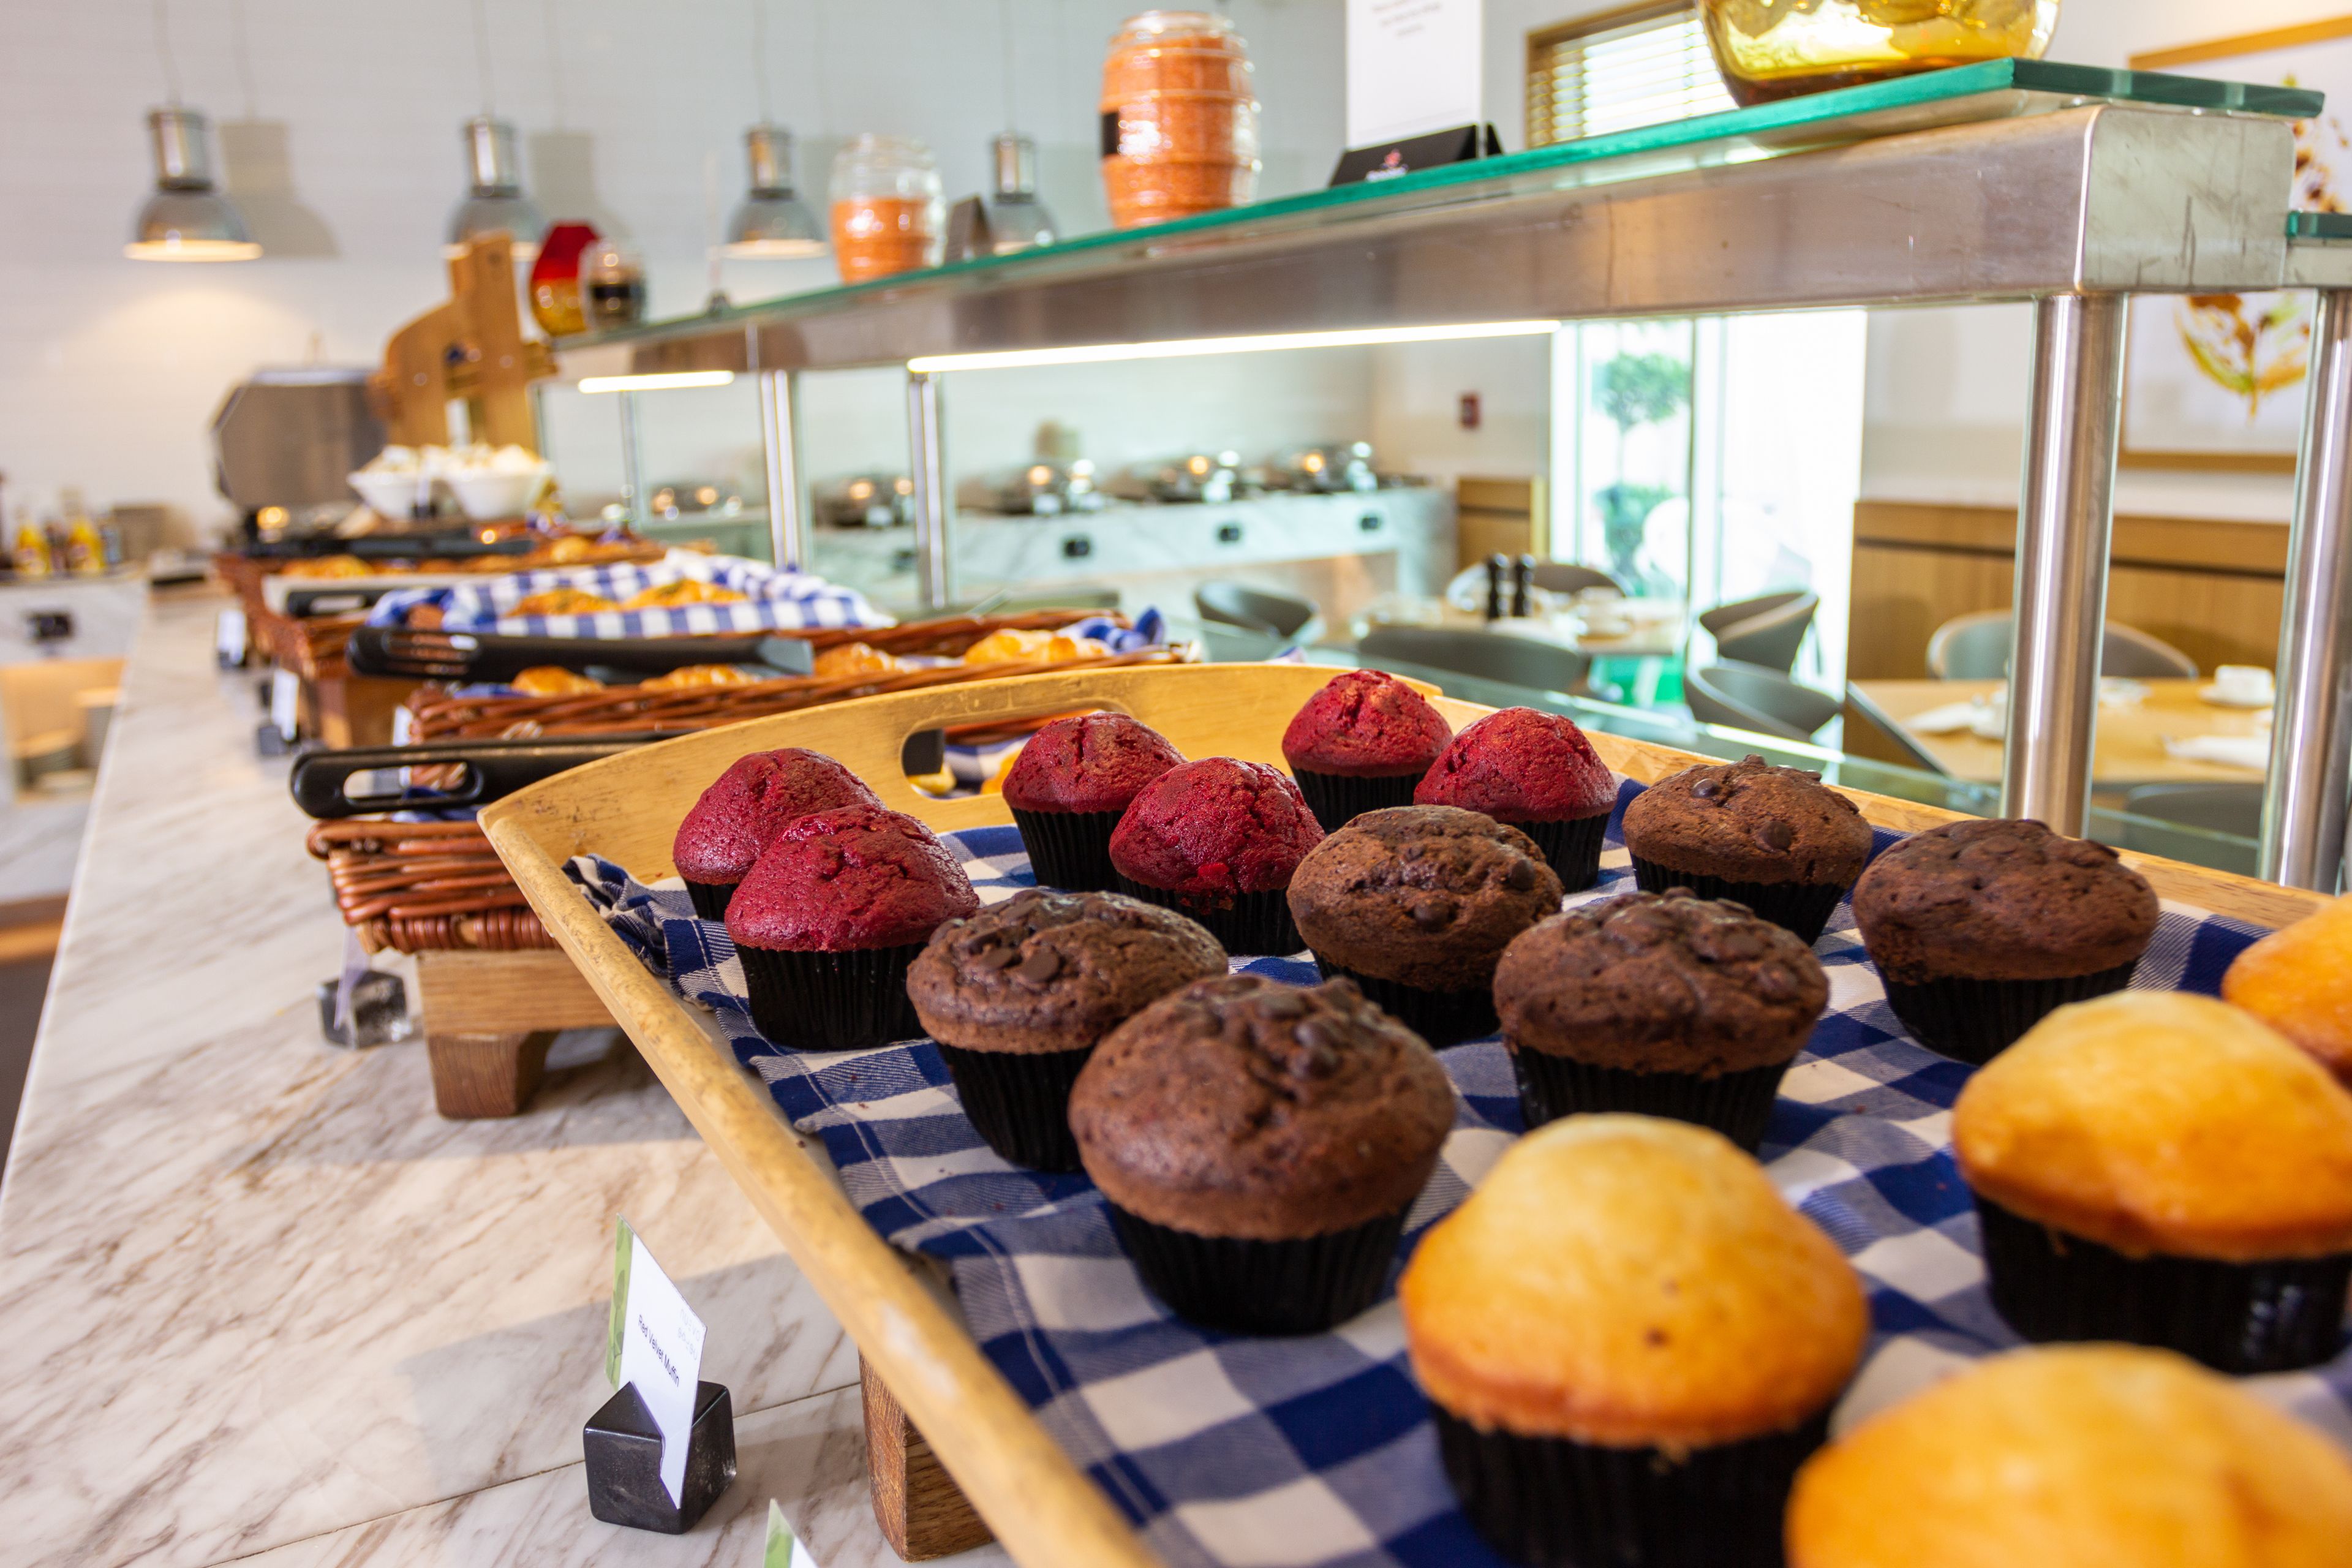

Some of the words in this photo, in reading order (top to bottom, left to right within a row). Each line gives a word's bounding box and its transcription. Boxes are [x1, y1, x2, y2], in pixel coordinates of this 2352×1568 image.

[638, 1314, 648, 1337] Red
[649, 1329, 664, 1363] Velvet
[664, 1354, 680, 1387] Muffin
